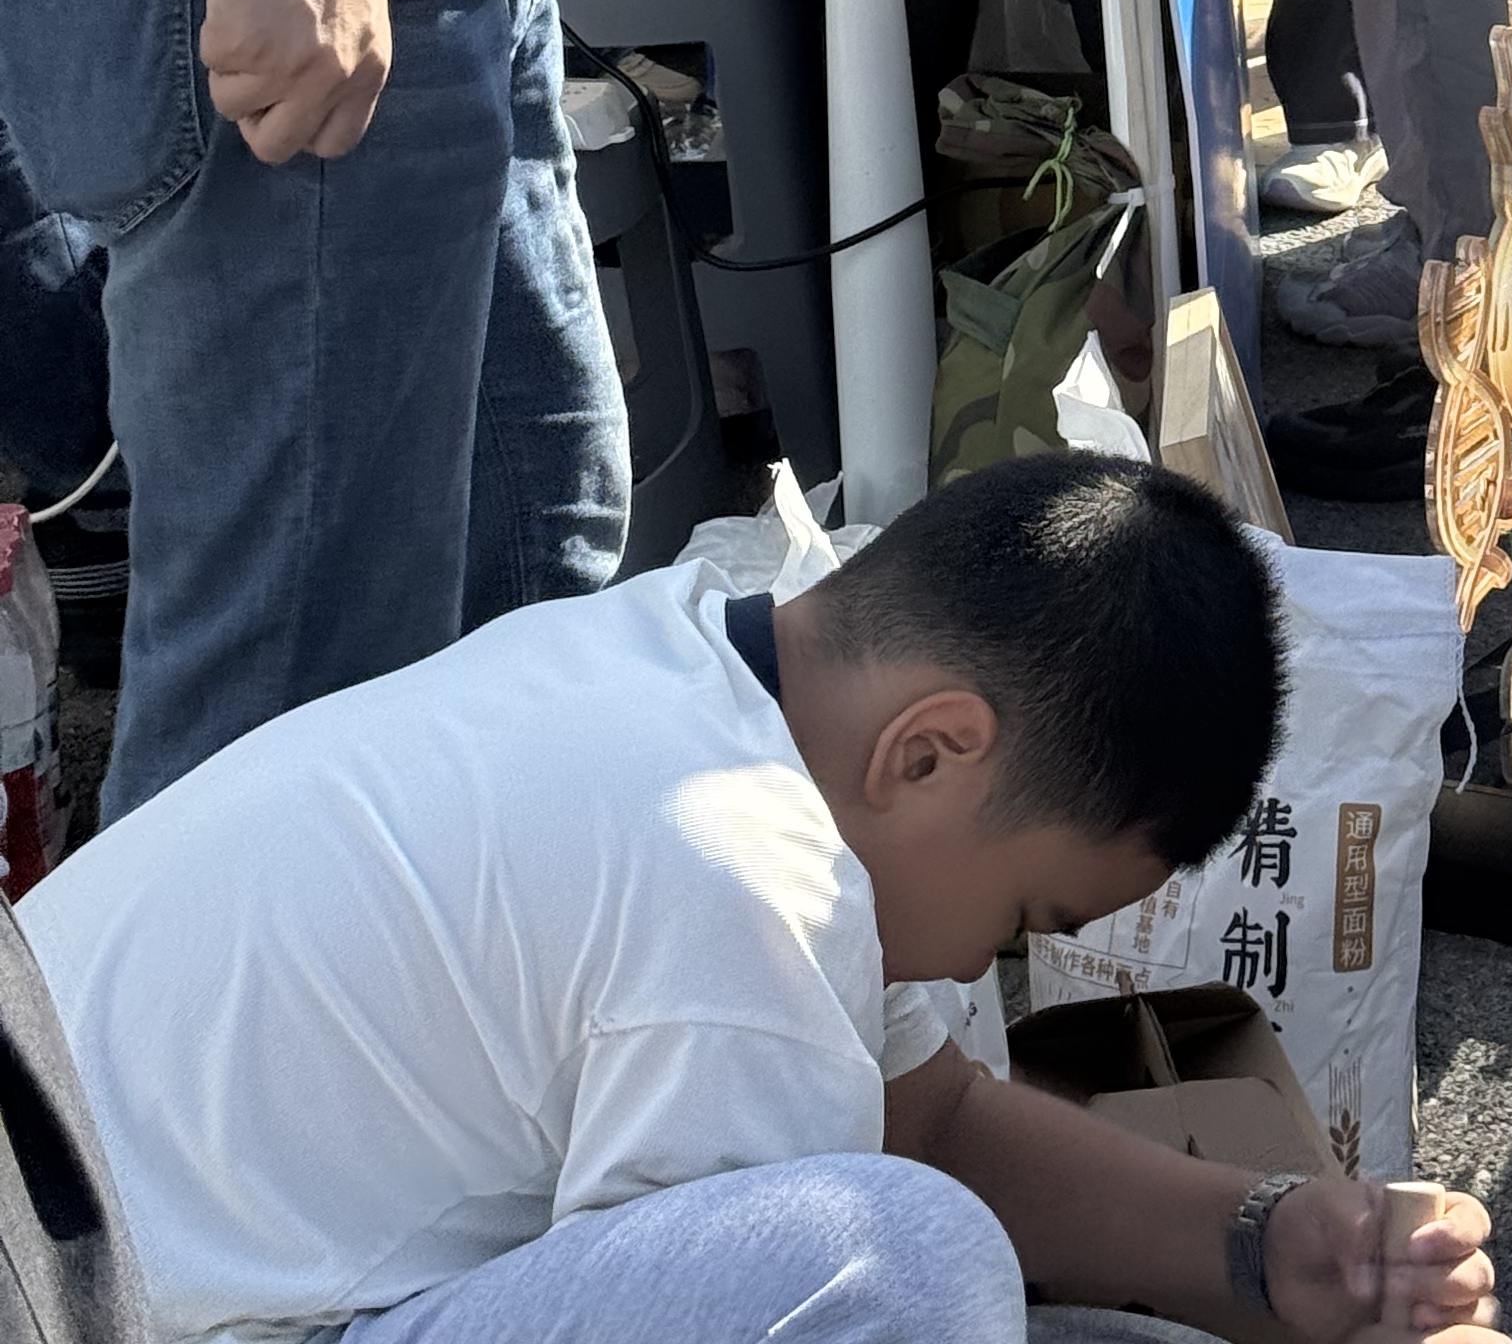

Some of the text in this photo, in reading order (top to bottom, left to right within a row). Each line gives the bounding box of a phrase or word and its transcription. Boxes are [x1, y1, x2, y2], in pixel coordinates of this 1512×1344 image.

[1161, 879, 1182, 920] 自有
[1219, 796, 1297, 1033] 精制
[1279, 893, 1305, 910] Jing
[1340, 810, 1374, 968] 通用型面粉
[1132, 892, 1158, 954] 植基地
[1274, 1000, 1294, 1013] Zhi
